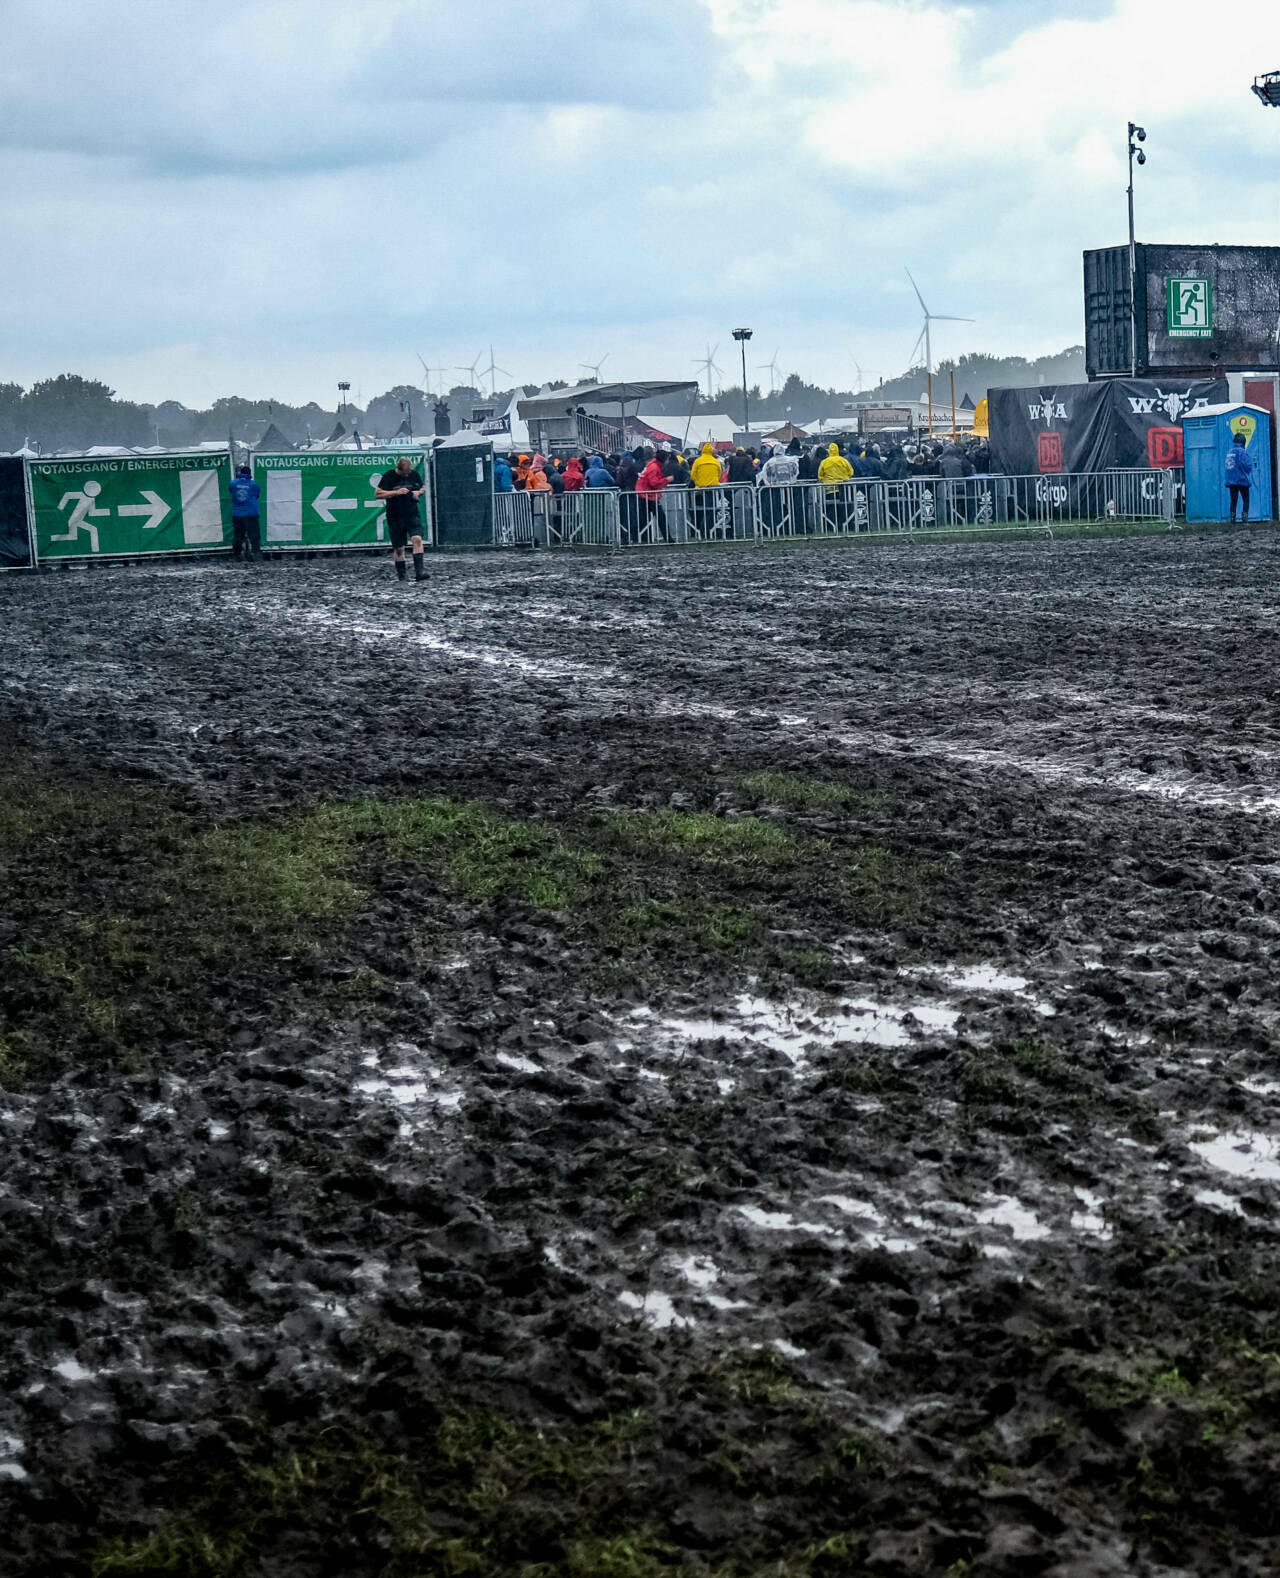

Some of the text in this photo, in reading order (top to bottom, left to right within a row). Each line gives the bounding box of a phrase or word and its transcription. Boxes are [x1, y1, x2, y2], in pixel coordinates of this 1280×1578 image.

[256, 457, 329, 468] NOTAUSGANG
[337, 455, 397, 467] EMERGENCY
[402, 455, 425, 467] XIT
[1040, 439, 1059, 466] DB
[1155, 433, 1184, 463] D
[33, 462, 118, 475] NOTAUSGANG
[127, 458, 200, 471] EMERGENCY
[202, 456, 228, 468] EXIT
[1036, 480, 1068, 507] Cargo
